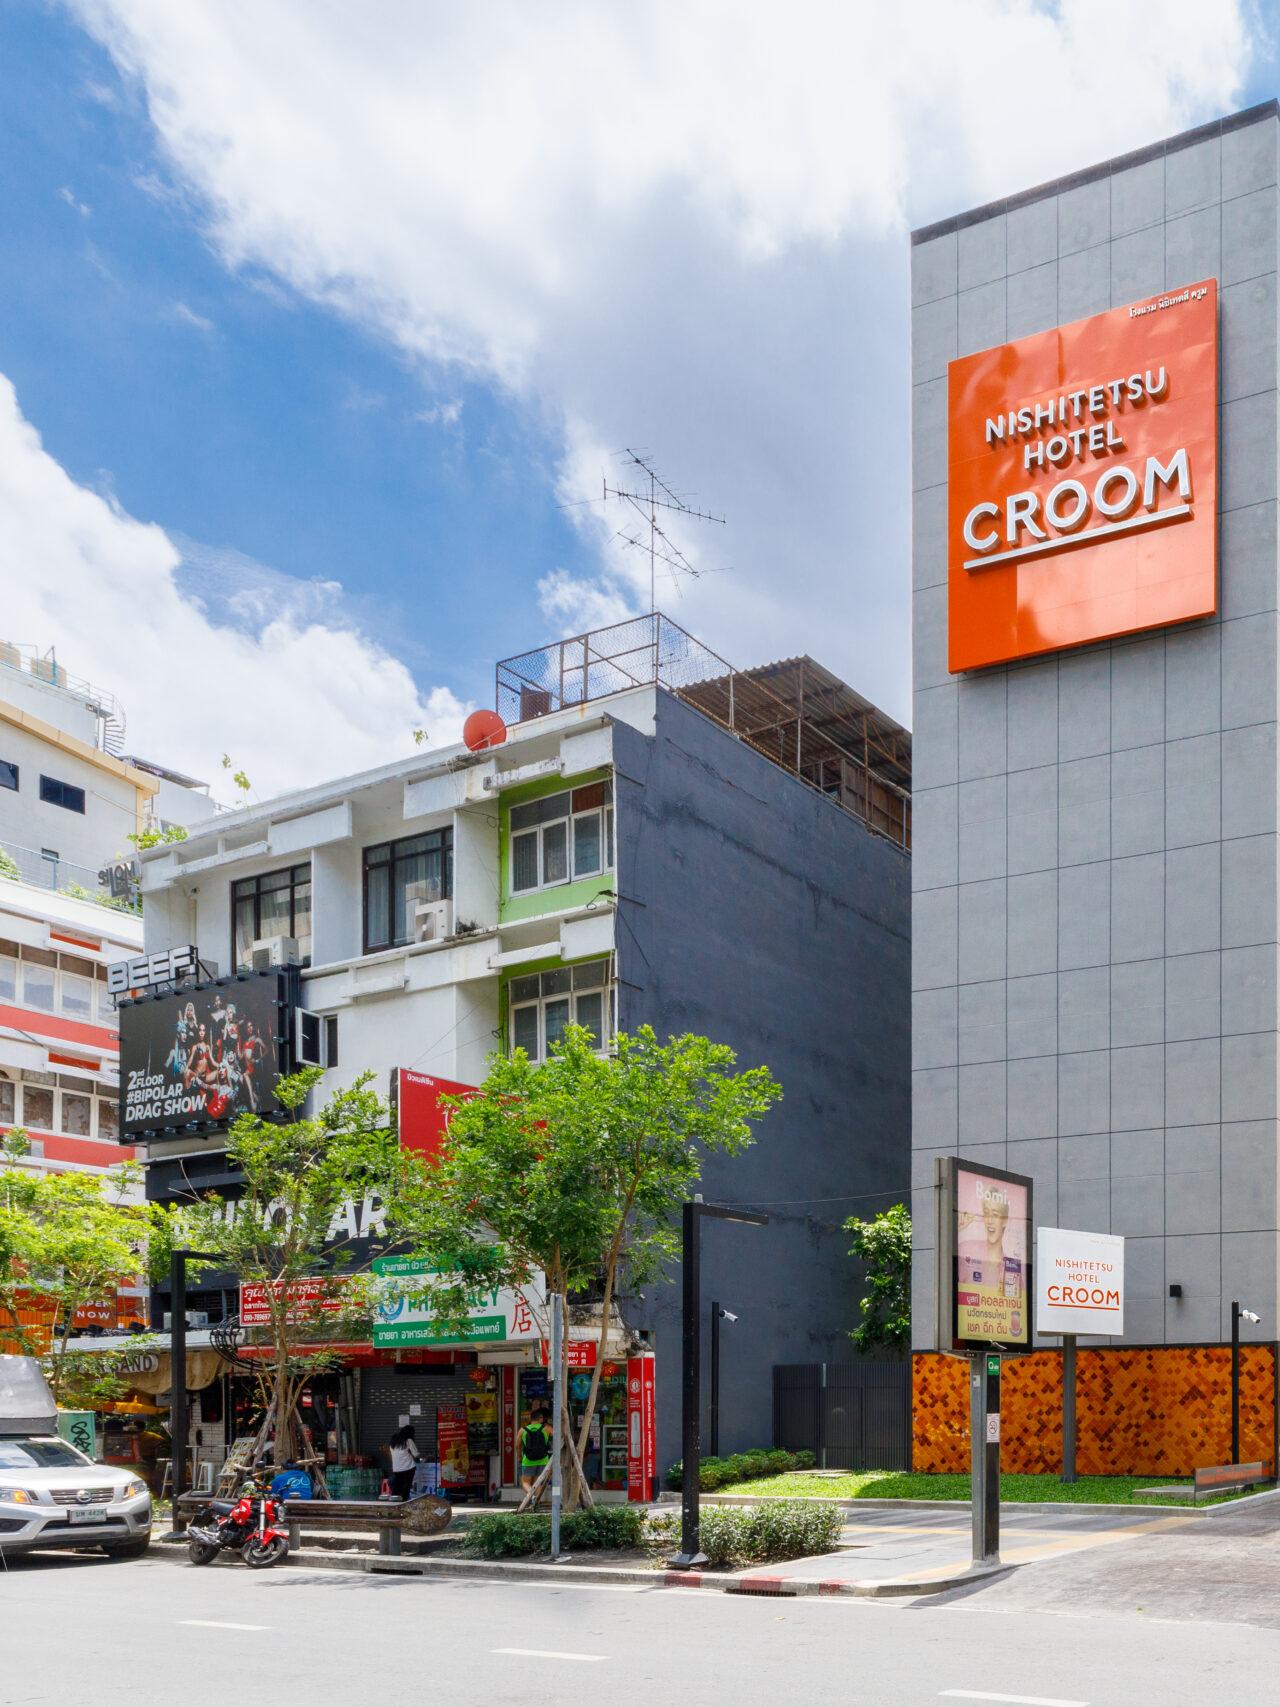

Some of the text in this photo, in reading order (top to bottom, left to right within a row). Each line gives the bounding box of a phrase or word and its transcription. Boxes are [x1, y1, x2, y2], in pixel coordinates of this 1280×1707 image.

[985, 366, 1168, 444] NISHITETSU
[1024, 420, 1125, 470] HOTEL
[963, 447, 1193, 553] CROOM
[135, 1074, 164, 1088] FLOOR
[126, 1083, 183, 1104] #BIPOLAR
[125, 1099, 162, 1122] DRAG
[1055, 1258, 1113, 1273] NISHITETSU
[1068, 1273, 1100, 1284] HOTEL
[1047, 1285, 1120, 1306] CROOM
[76, 1310, 110, 1319] NOW
[378, 1331, 398, 1340] ขายยา
